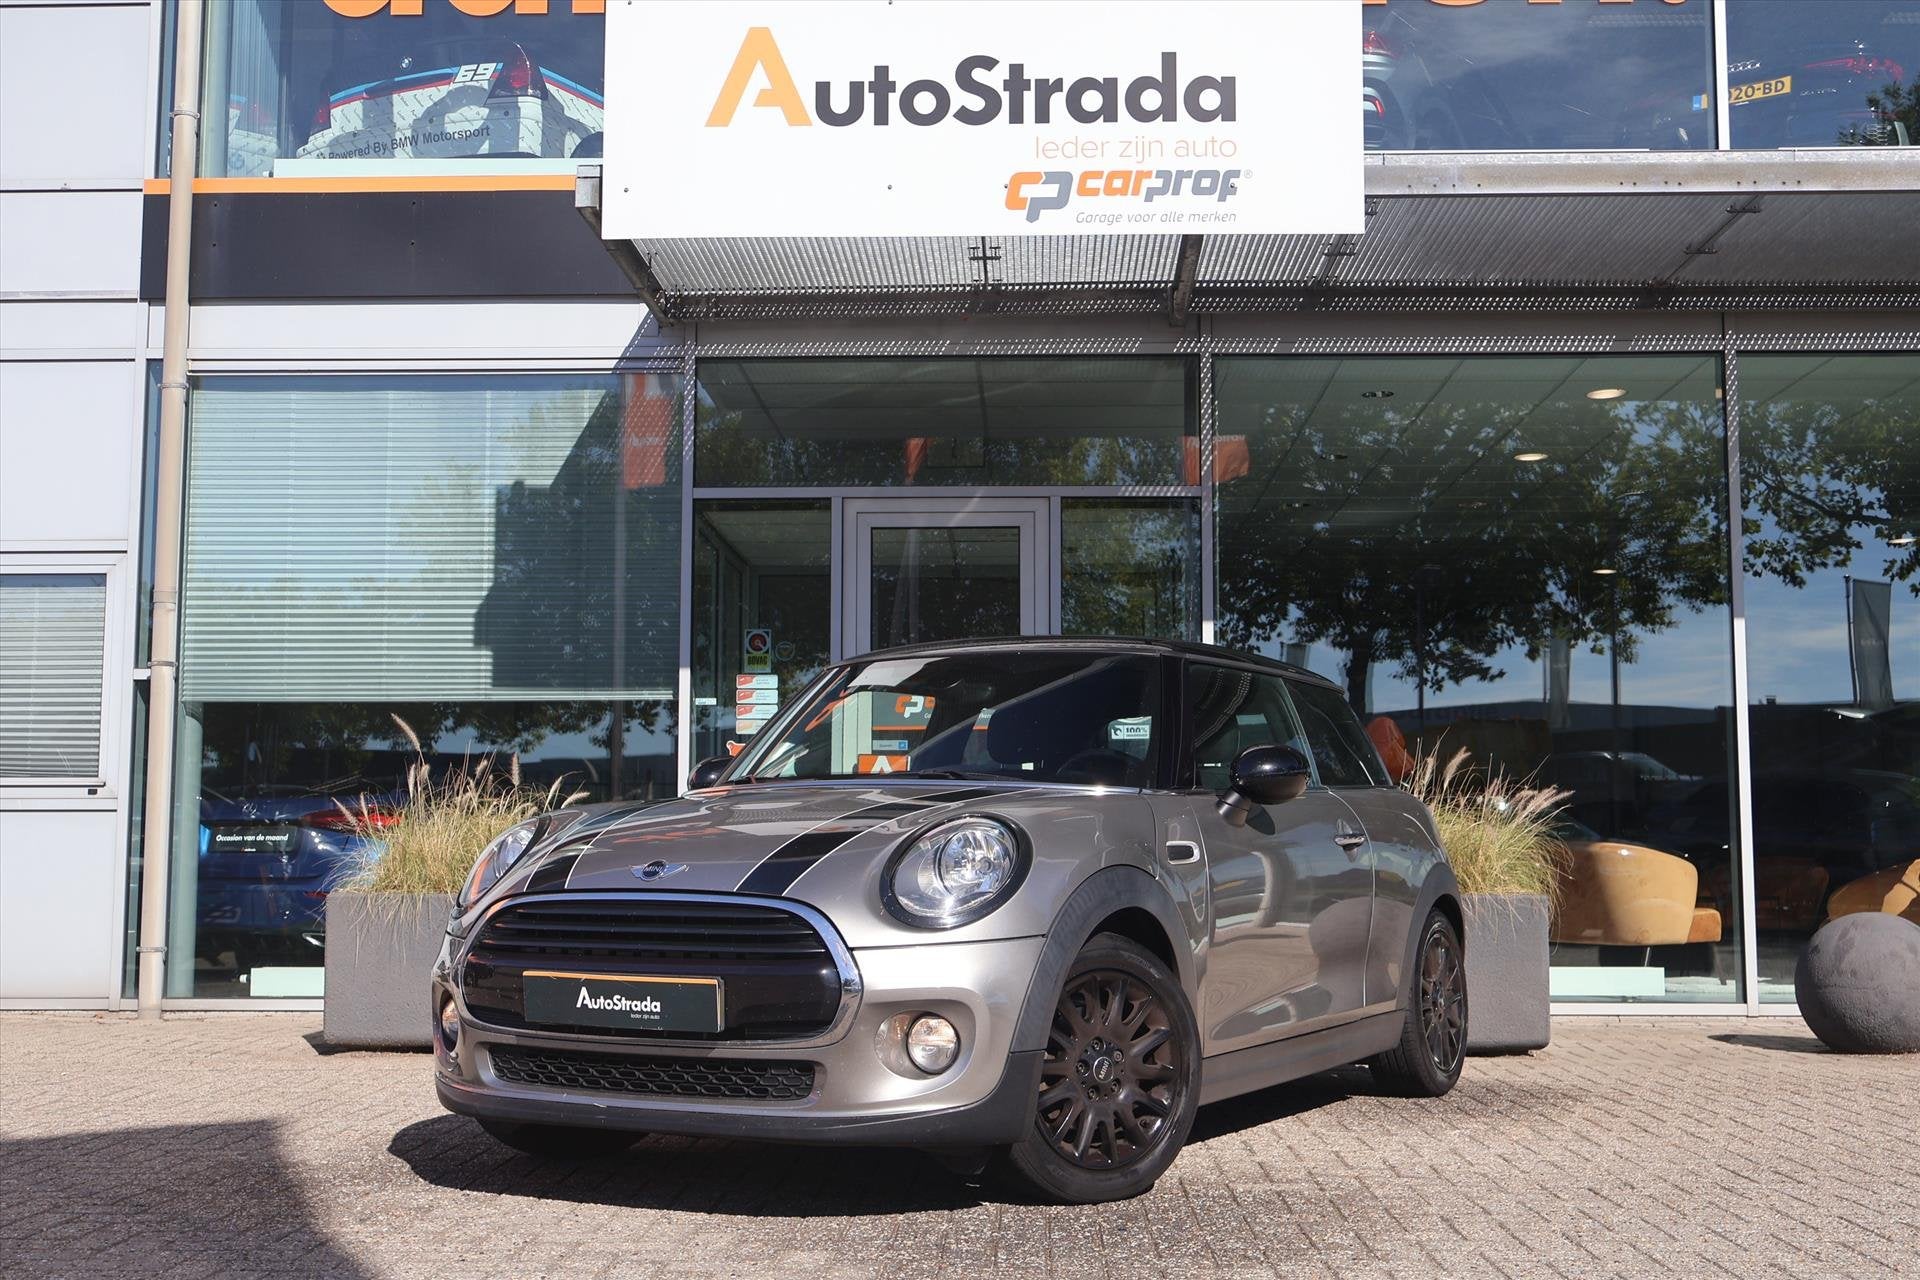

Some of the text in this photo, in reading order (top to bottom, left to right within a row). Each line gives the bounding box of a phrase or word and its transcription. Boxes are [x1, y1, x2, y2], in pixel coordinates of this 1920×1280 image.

[455, 63, 496, 82] 69
[705, 27, 1237, 127] AutoStrada
[328, 143, 370, 158] Powered
[373, 142, 388, 155] By
[391, 134, 419, 150] BMW
[422, 125, 490, 145] Motorsport
[1035, 135, 1238, 164] Ieder zijn auto
[1076, 211, 1237, 225] Garage voor alle merken
[216, 834, 242, 842] Occasion
[576, 986, 661, 1013] AutoStrada
[1098, 1060, 1110, 1080] MINI
